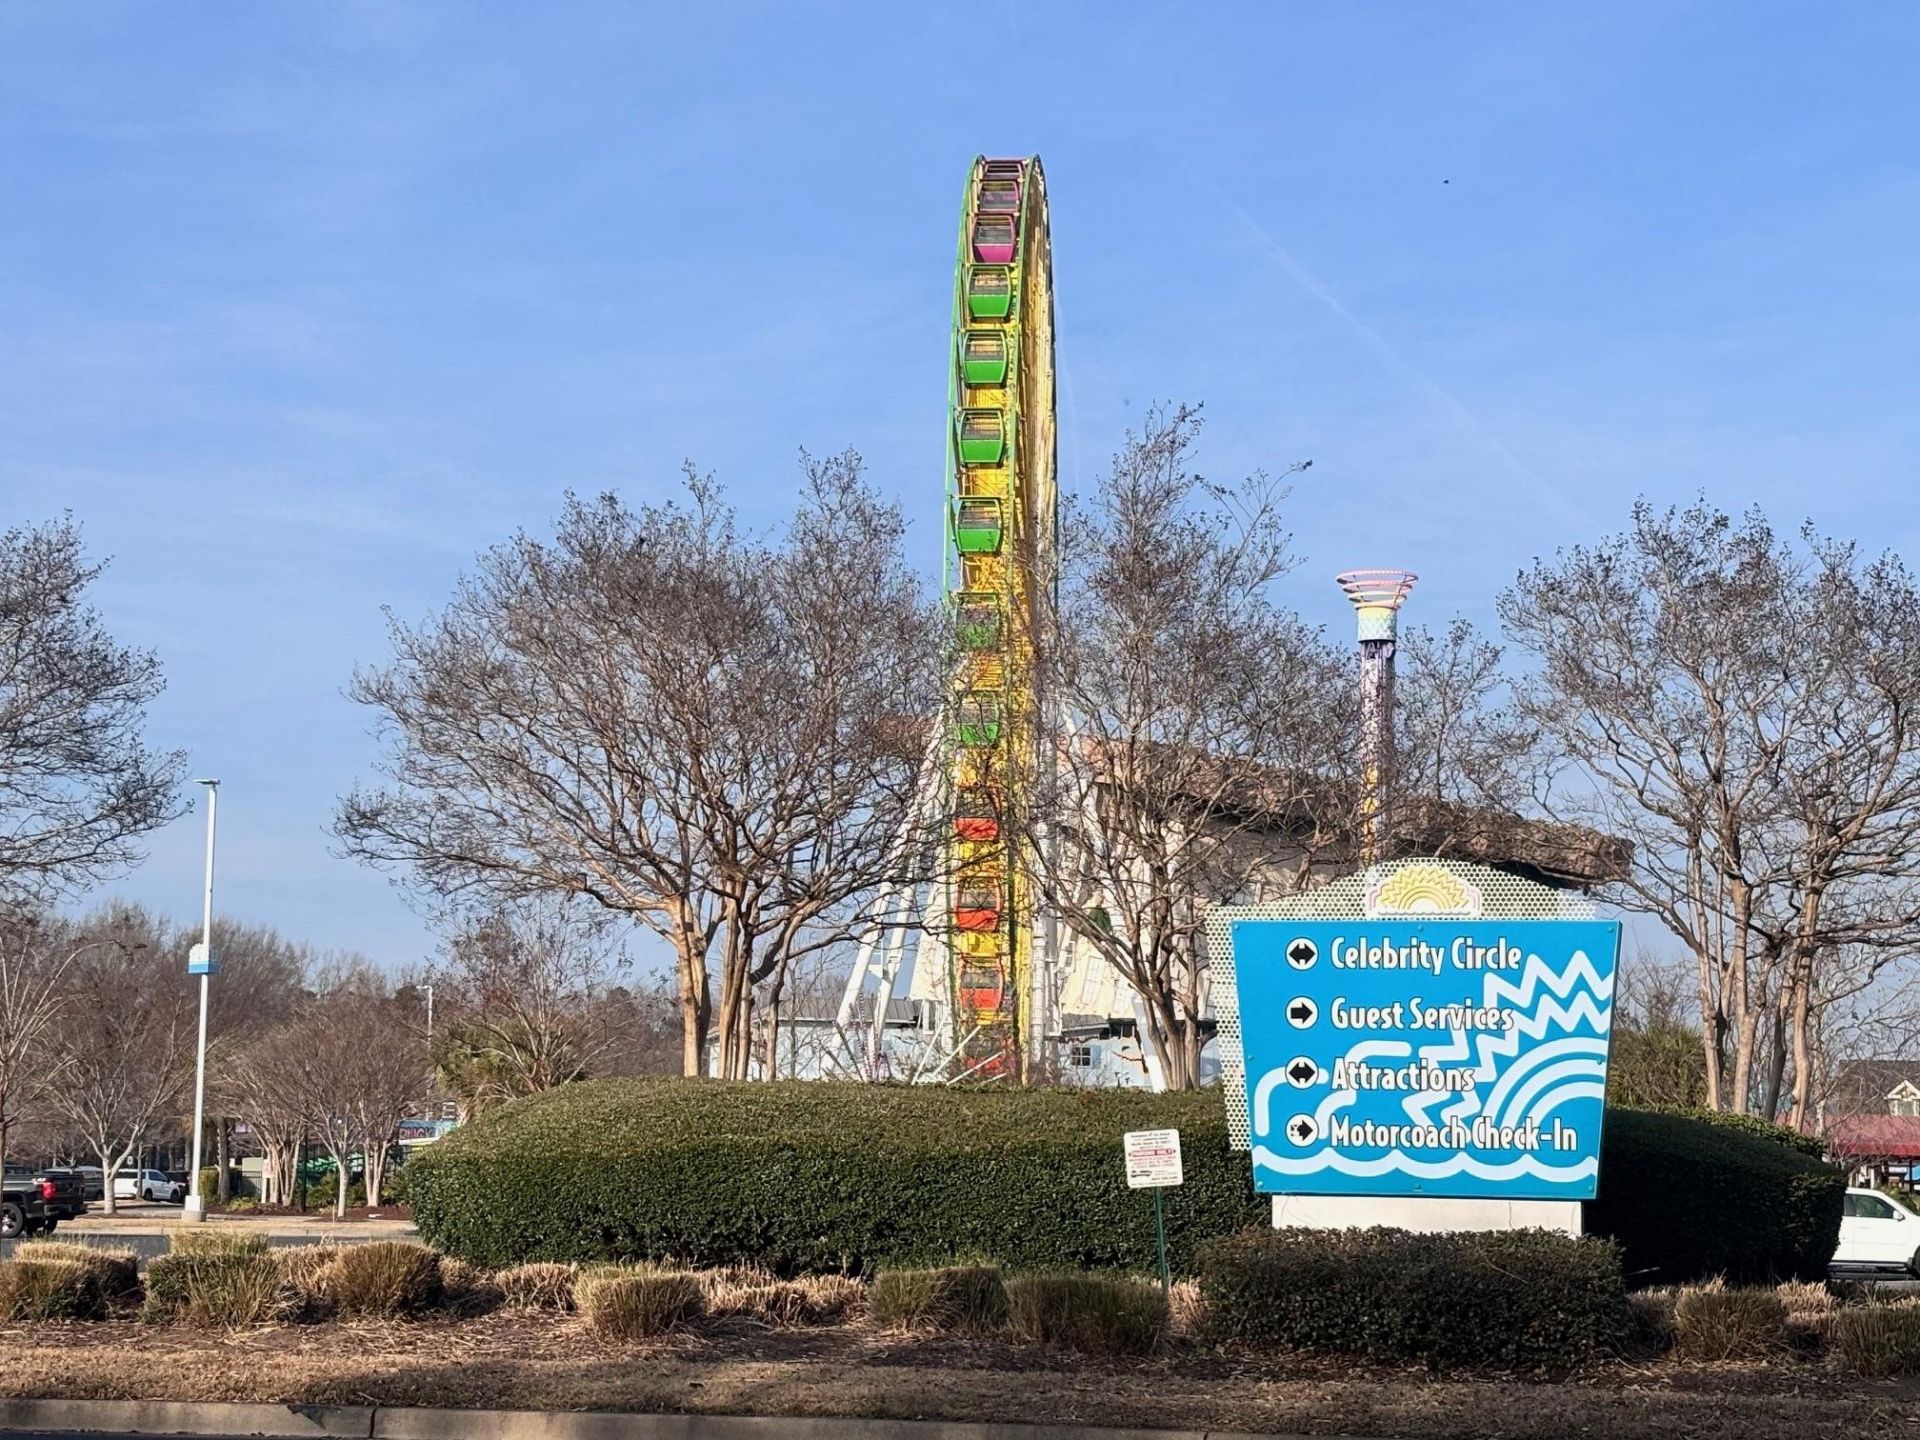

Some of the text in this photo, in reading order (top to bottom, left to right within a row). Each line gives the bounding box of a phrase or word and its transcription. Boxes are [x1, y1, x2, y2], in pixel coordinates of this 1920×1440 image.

[1331, 936, 1522, 976] Celebrity Circle
[1331, 996, 1514, 1031] Guest Services
[1331, 1057, 1476, 1092] Attractions
[1329, 1113, 1577, 1151] Motorcoach Check-In
